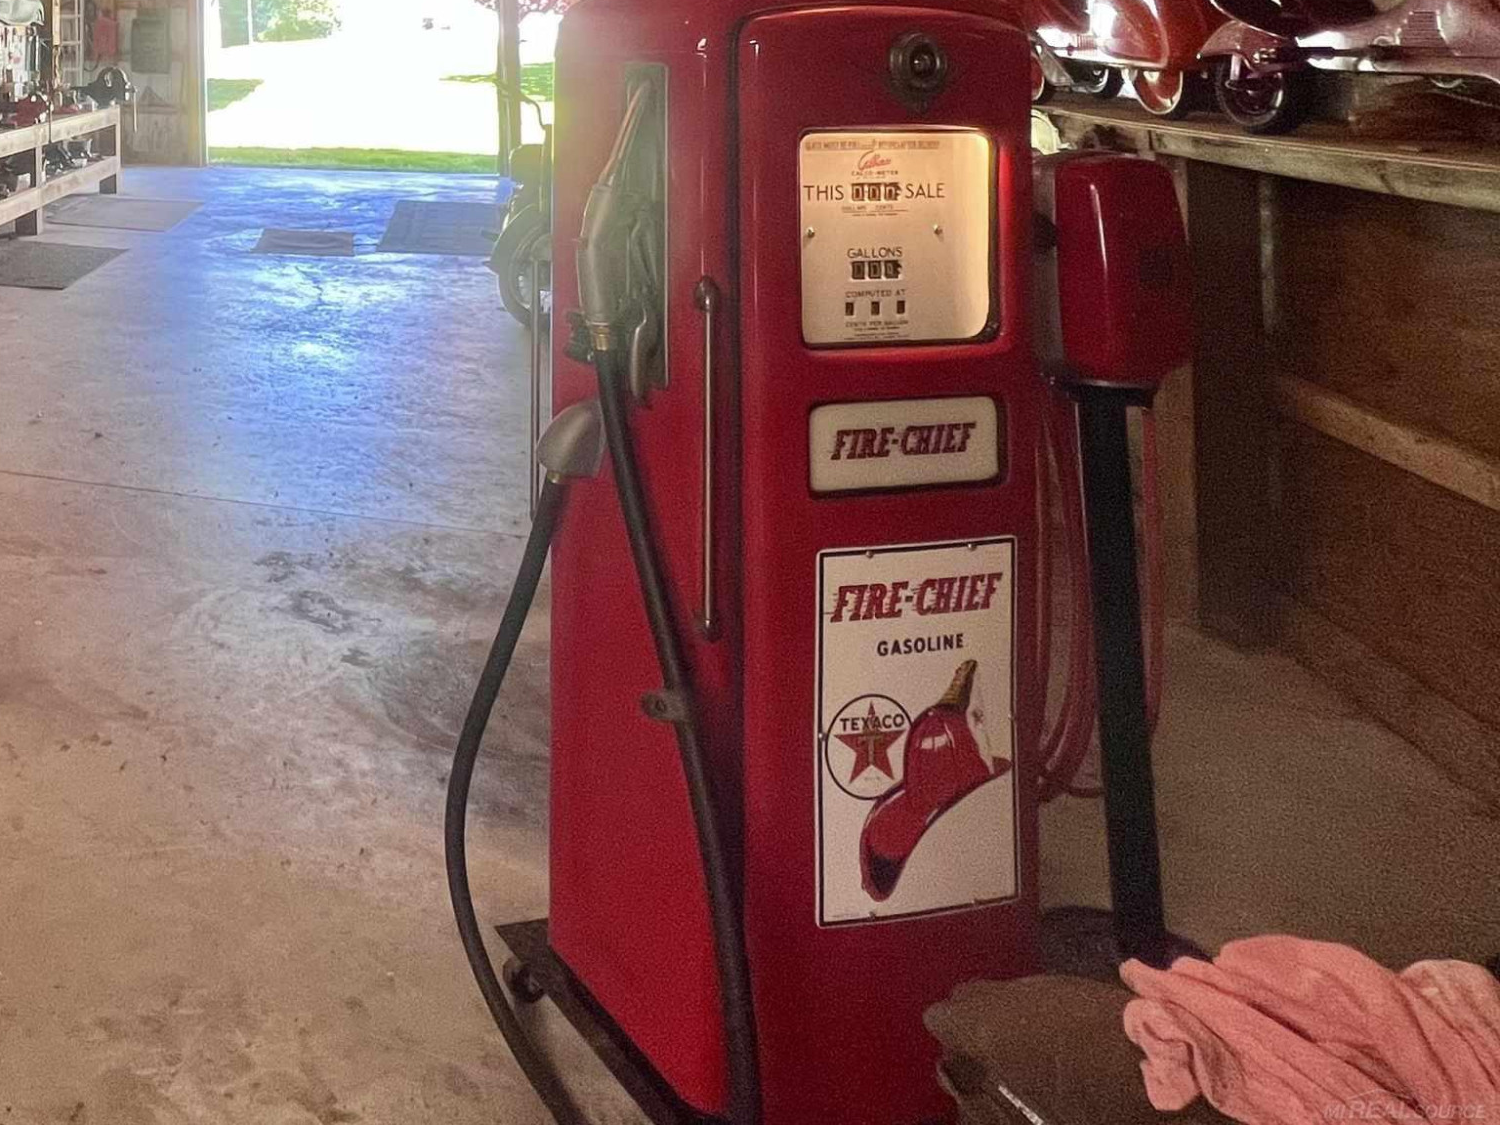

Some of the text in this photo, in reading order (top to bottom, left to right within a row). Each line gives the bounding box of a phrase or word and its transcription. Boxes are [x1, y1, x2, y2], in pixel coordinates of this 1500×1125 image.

[803, 185, 844, 201] THIS
[905, 183, 946, 199] SALE
[847, 247, 903, 259] GALLONS
[830, 422, 977, 461] FIRE-CHIEF
[830, 572, 1003, 623] FIRE-CHIEF
[877, 633, 965, 656] GASOLINE
[840, 713, 905, 732] TEXACO
